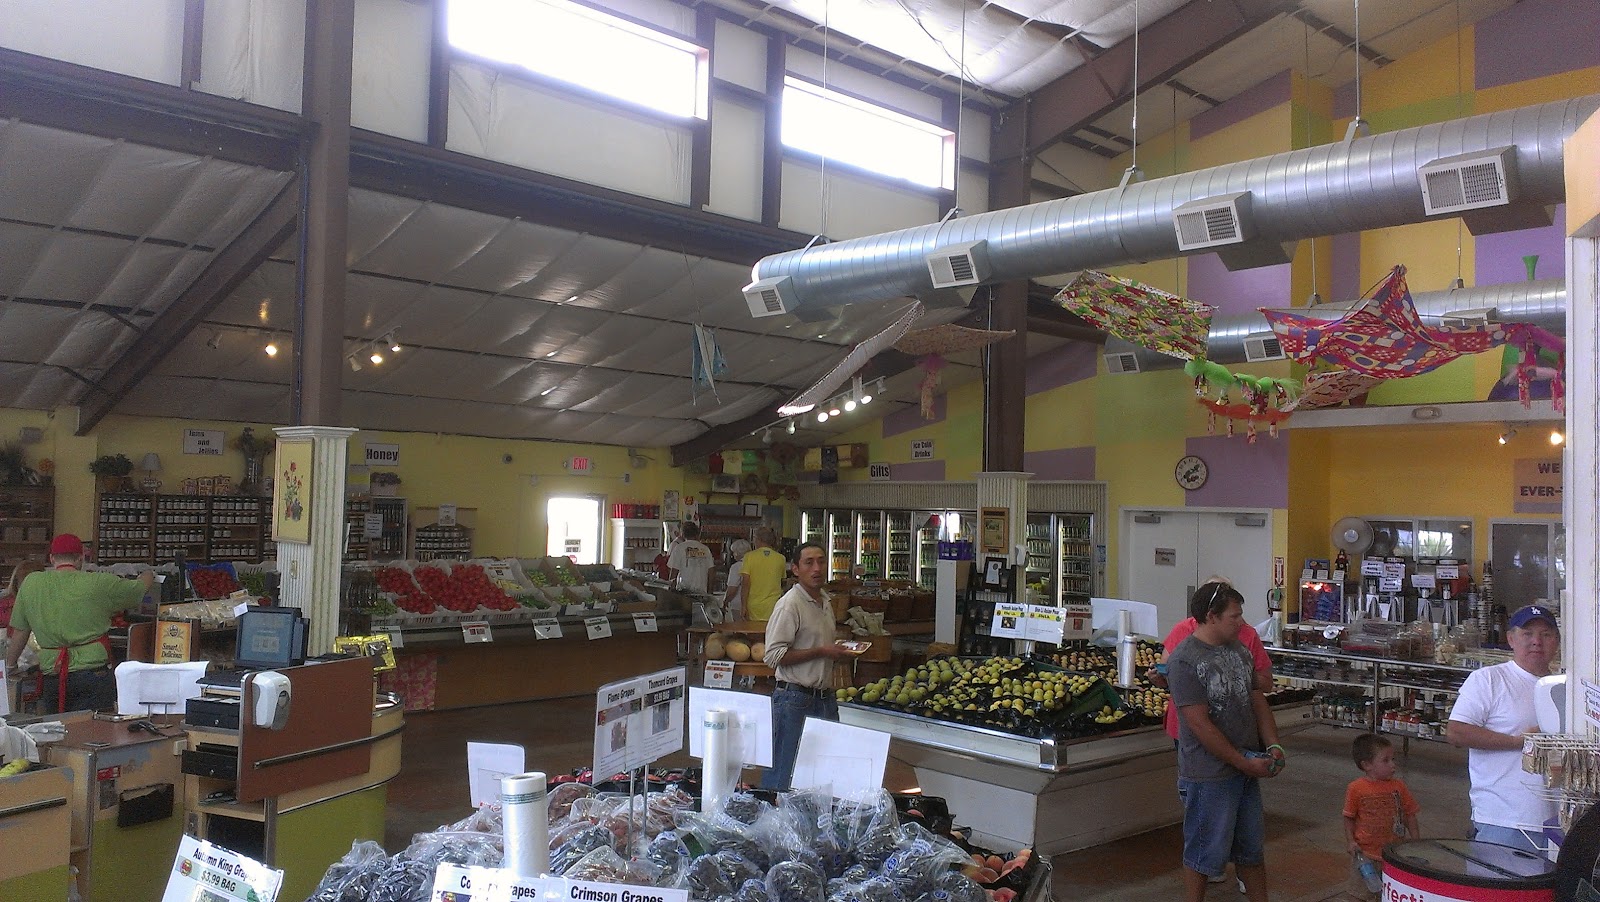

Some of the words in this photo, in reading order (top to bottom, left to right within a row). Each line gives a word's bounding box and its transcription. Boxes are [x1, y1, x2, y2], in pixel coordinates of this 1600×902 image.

[366, 448, 398, 461] Honey
[914, 450, 931, 458] Drinks
[573, 457, 588, 469] EXIT
[870, 464, 890, 478] Gifts
[1520, 485, 1563, 497] EVER-
[666, 675, 678, 686] Grapes
[607, 691, 620, 704] Flame
[620, 687, 636, 699] Grapes
[217, 857, 234, 875] King
[234, 864, 257, 882] Grap
[201, 870, 220, 886] $3.99
[220, 878, 237, 893] BAG
[570, 885, 618, 902] Crimson
[621, 889, 664, 902] Grapes
